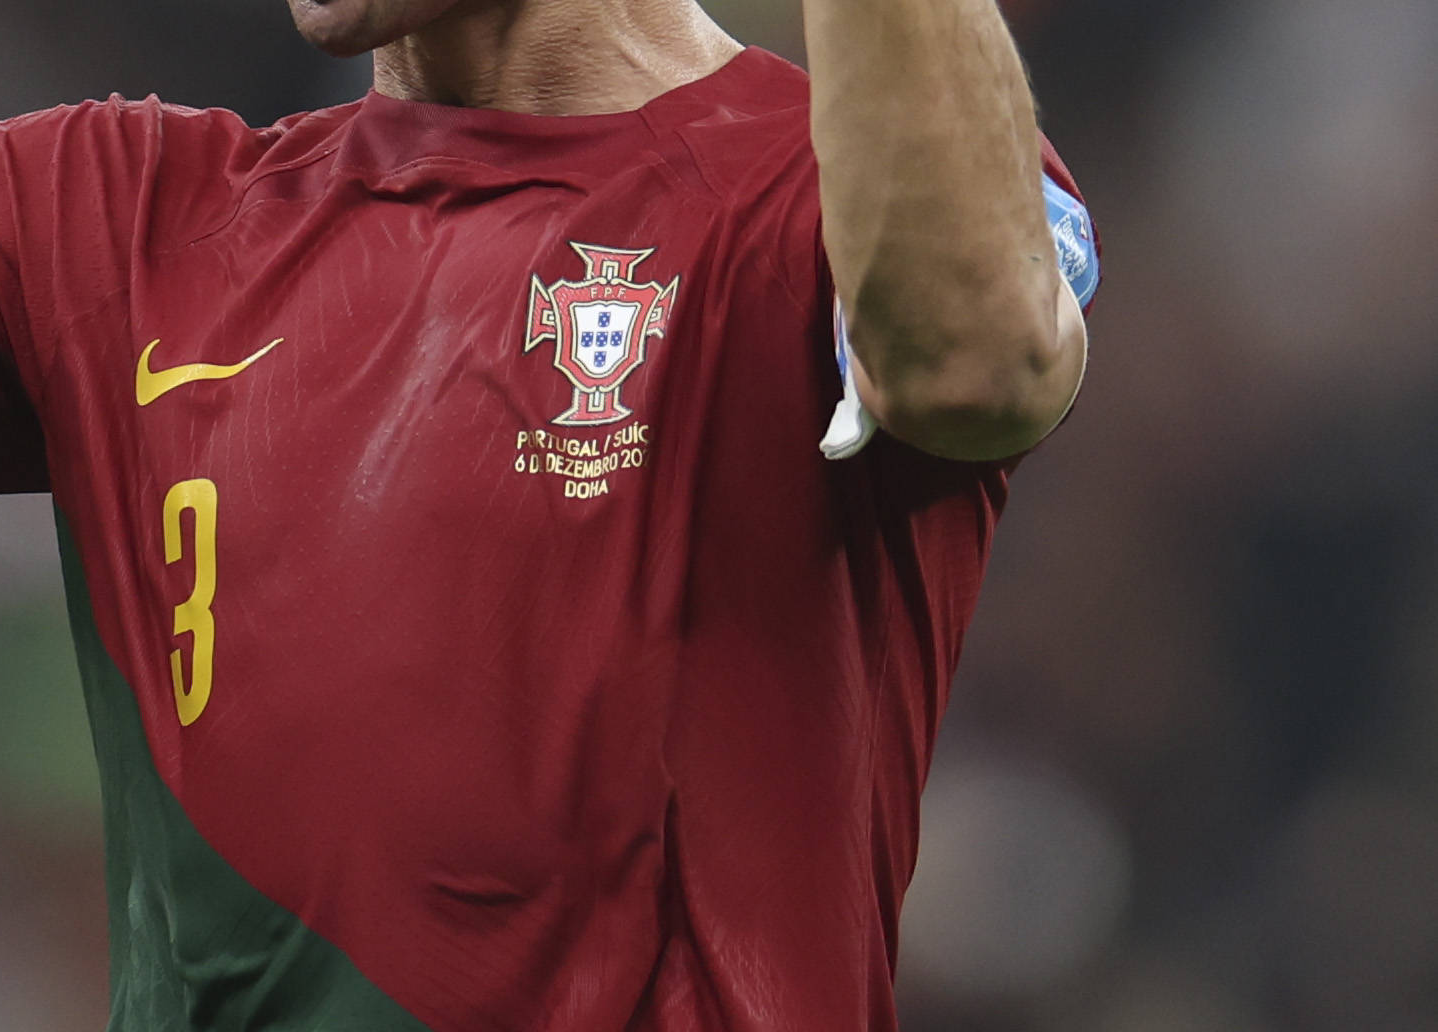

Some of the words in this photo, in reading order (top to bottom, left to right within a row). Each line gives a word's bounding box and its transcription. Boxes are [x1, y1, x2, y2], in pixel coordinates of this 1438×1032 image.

[517, 429, 600, 457] PORTUGAL
[515, 453, 526, 472] 6
[546, 452, 618, 479] DEZEMBRO
[565, 479, 609, 499] DOHA
[163, 478, 218, 727] 3
